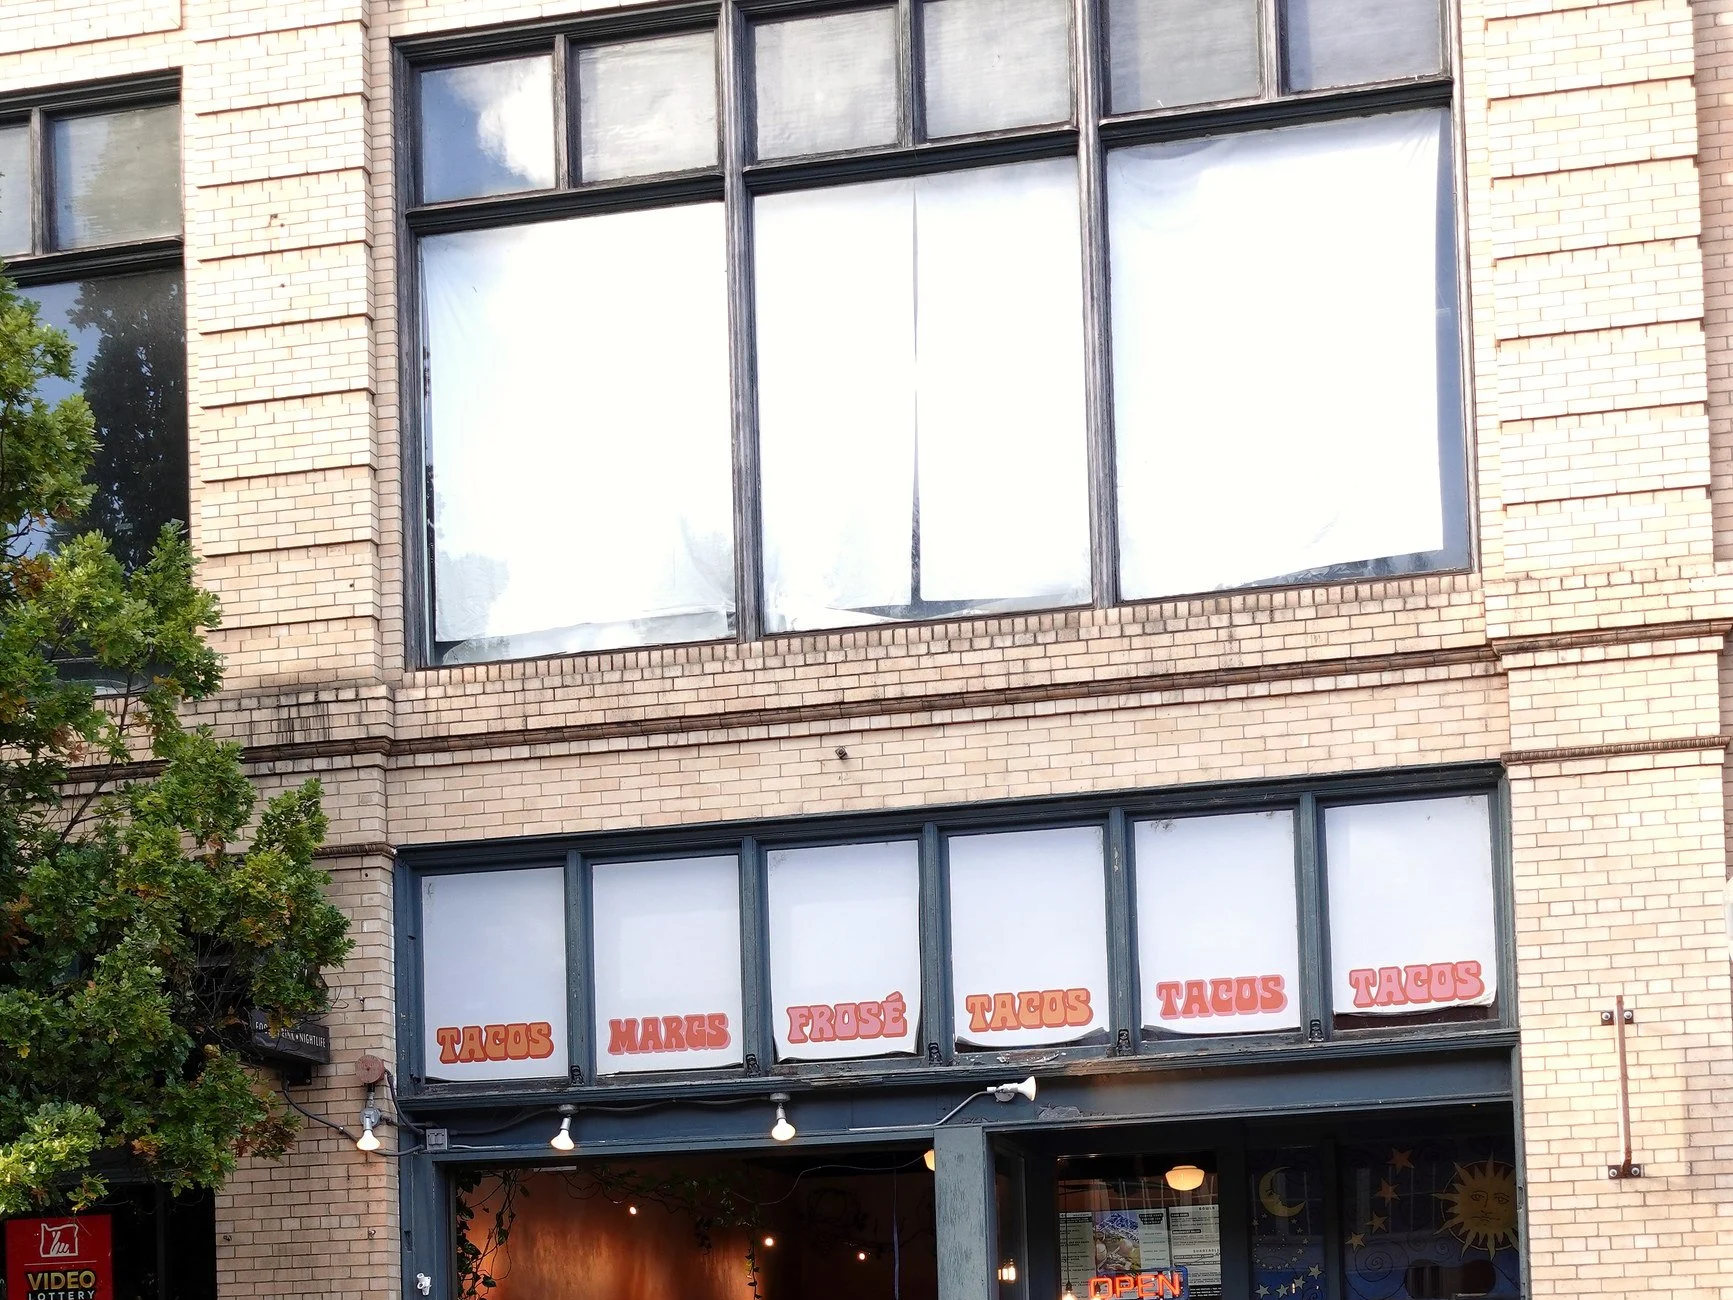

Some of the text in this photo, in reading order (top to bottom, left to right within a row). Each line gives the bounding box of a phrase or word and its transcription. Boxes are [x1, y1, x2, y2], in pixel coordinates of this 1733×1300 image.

[1156, 974, 1288, 1020] TACOS
[1349, 960, 1485, 1008] TACOS
[786, 991, 909, 1045] FROSÉ
[965, 988, 1094, 1032] TACOS
[300, 1033, 326, 1048] NIGHTLIFE
[437, 1021, 555, 1064] TACOS
[607, 1012, 731, 1055] MARGS
[27, 1270, 96, 1290] VIDEO
[1088, 1272, 1181, 1300] OPEN
